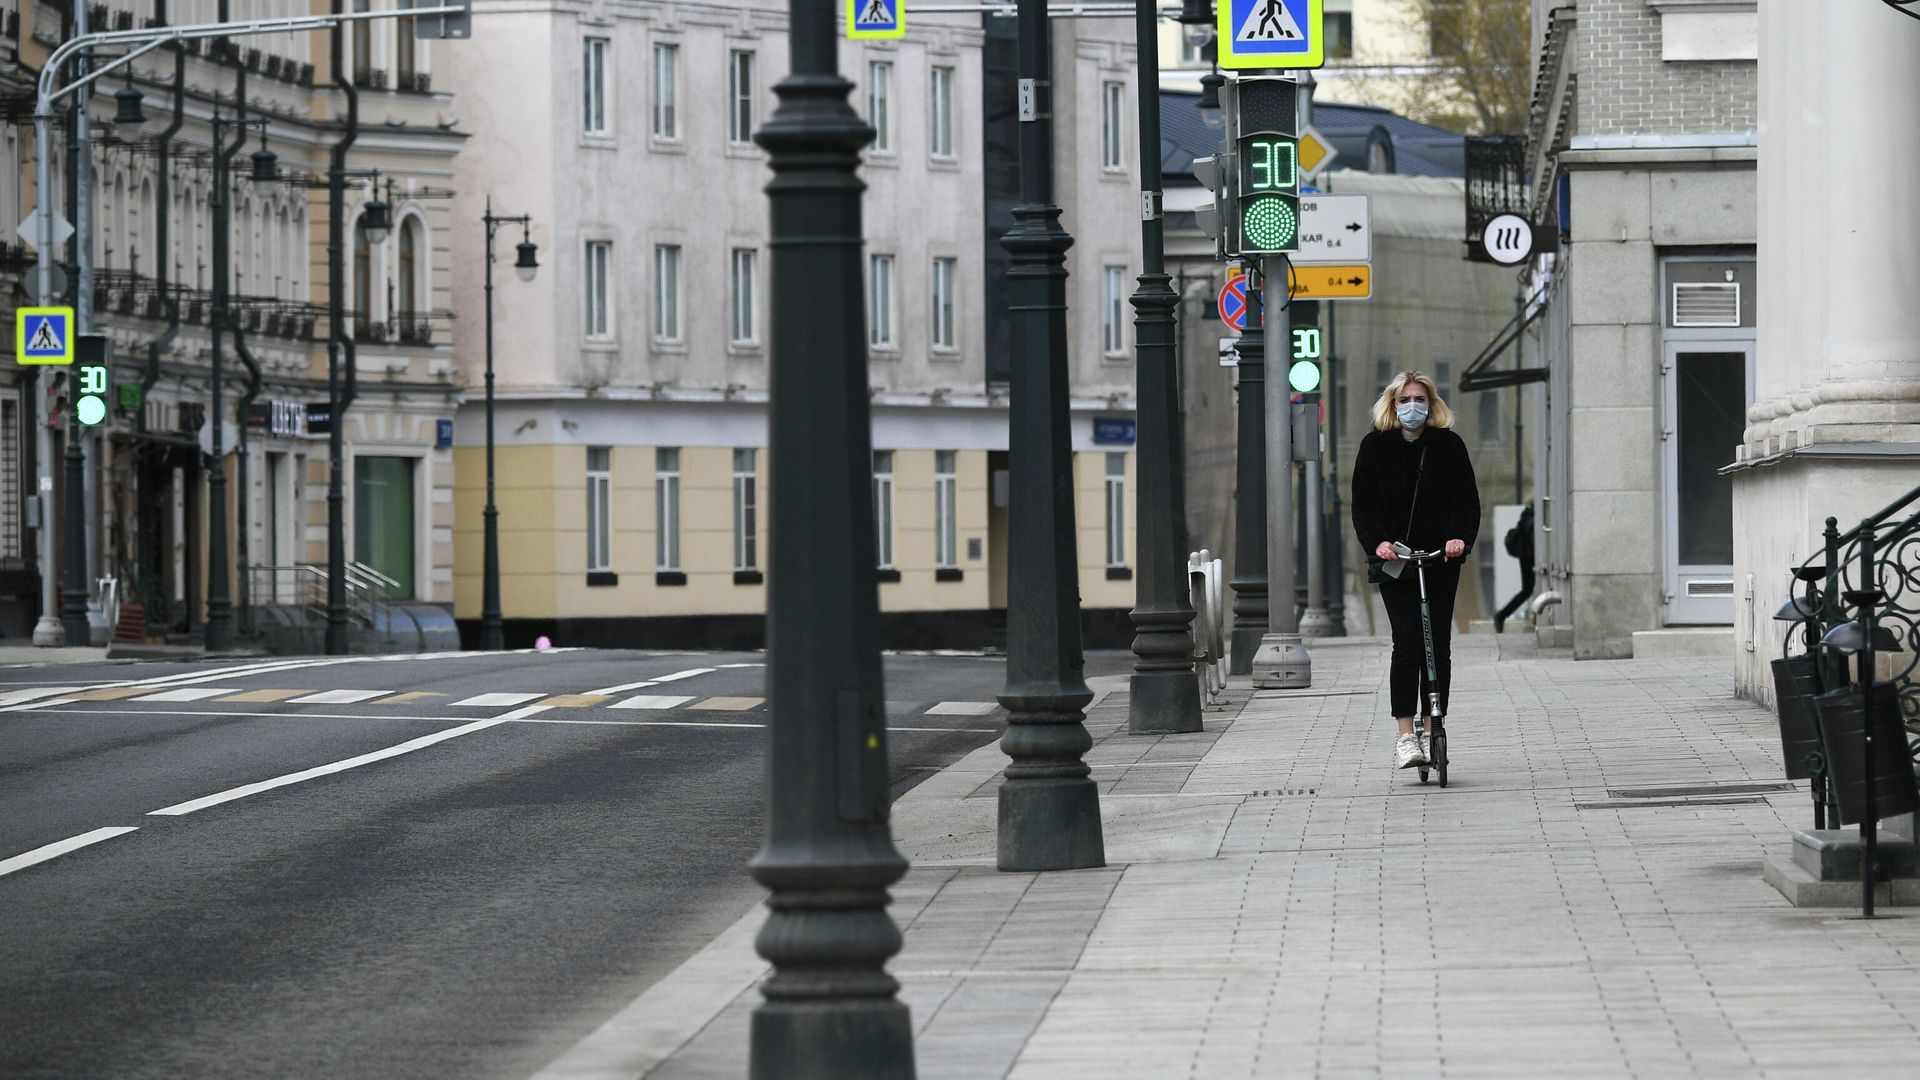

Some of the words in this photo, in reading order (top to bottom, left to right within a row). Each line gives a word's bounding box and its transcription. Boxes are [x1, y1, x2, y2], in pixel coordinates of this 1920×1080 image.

[1251, 142, 1296, 188] 30
[1300, 203, 1317, 211] ОВ
[1327, 240, 1341, 248] 0.4
[1328, 278, 1342, 286] 0.4
[1293, 329, 1320, 358] 30
[80, 366, 107, 393] 30
